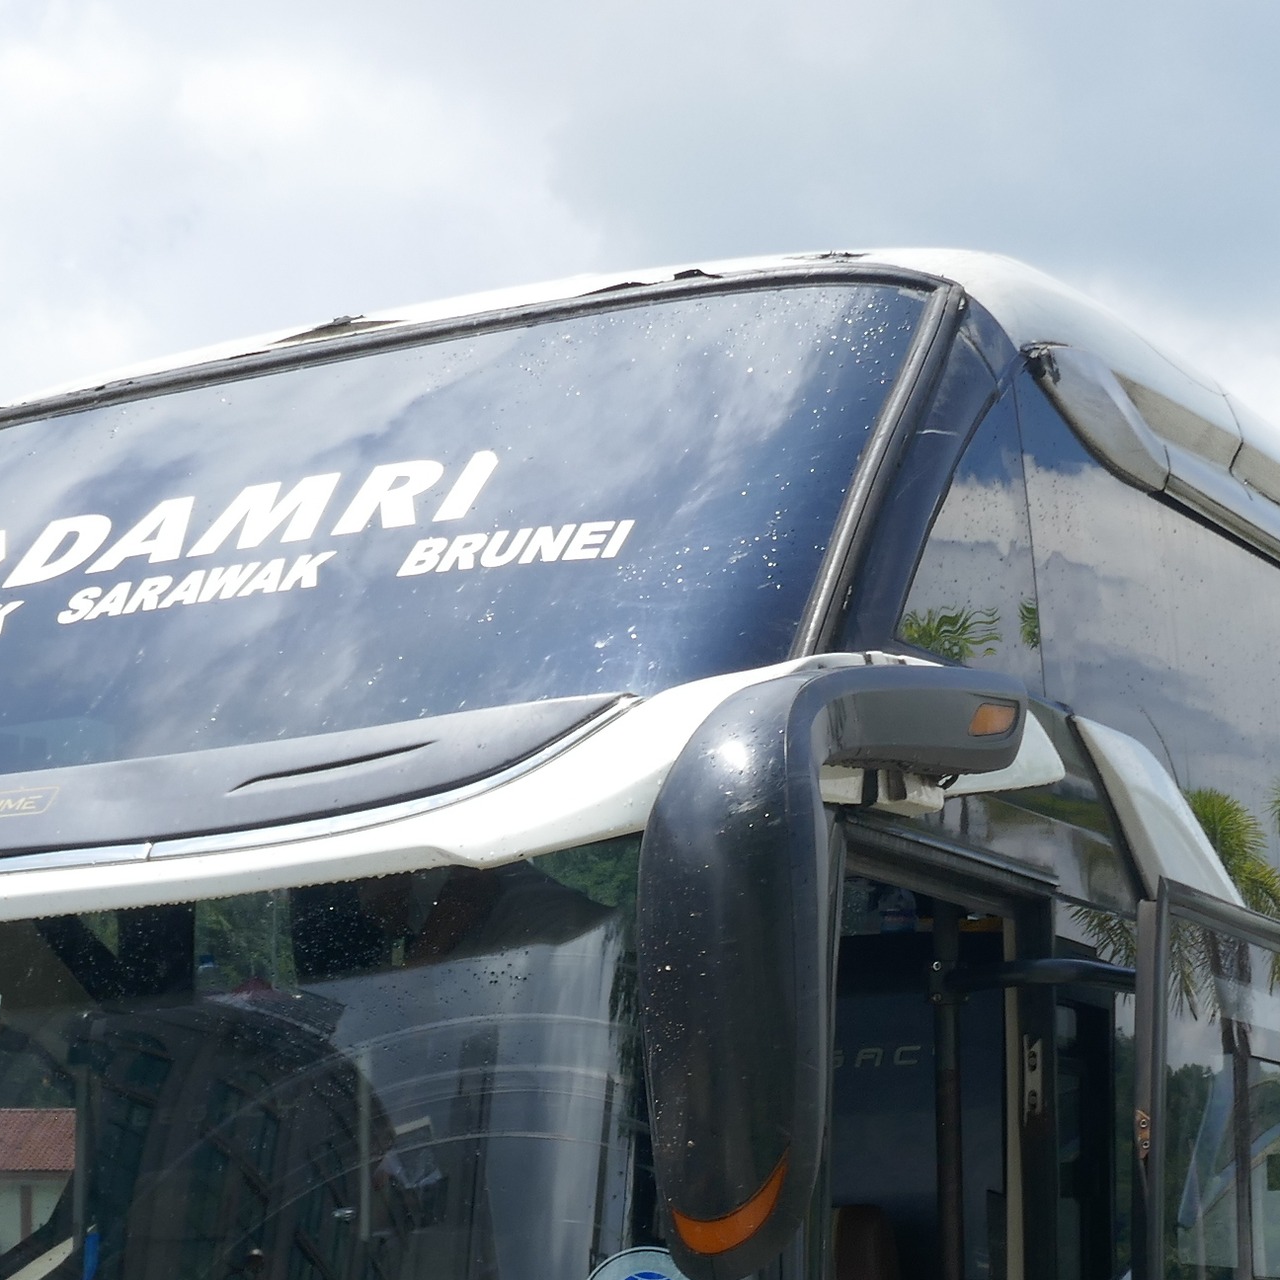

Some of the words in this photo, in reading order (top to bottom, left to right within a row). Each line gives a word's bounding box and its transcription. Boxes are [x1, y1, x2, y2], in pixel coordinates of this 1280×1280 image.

[2, 450, 499, 589] DAMRI
[57, 551, 338, 625] SARAWAK
[396, 519, 635, 577] BRUNEI
